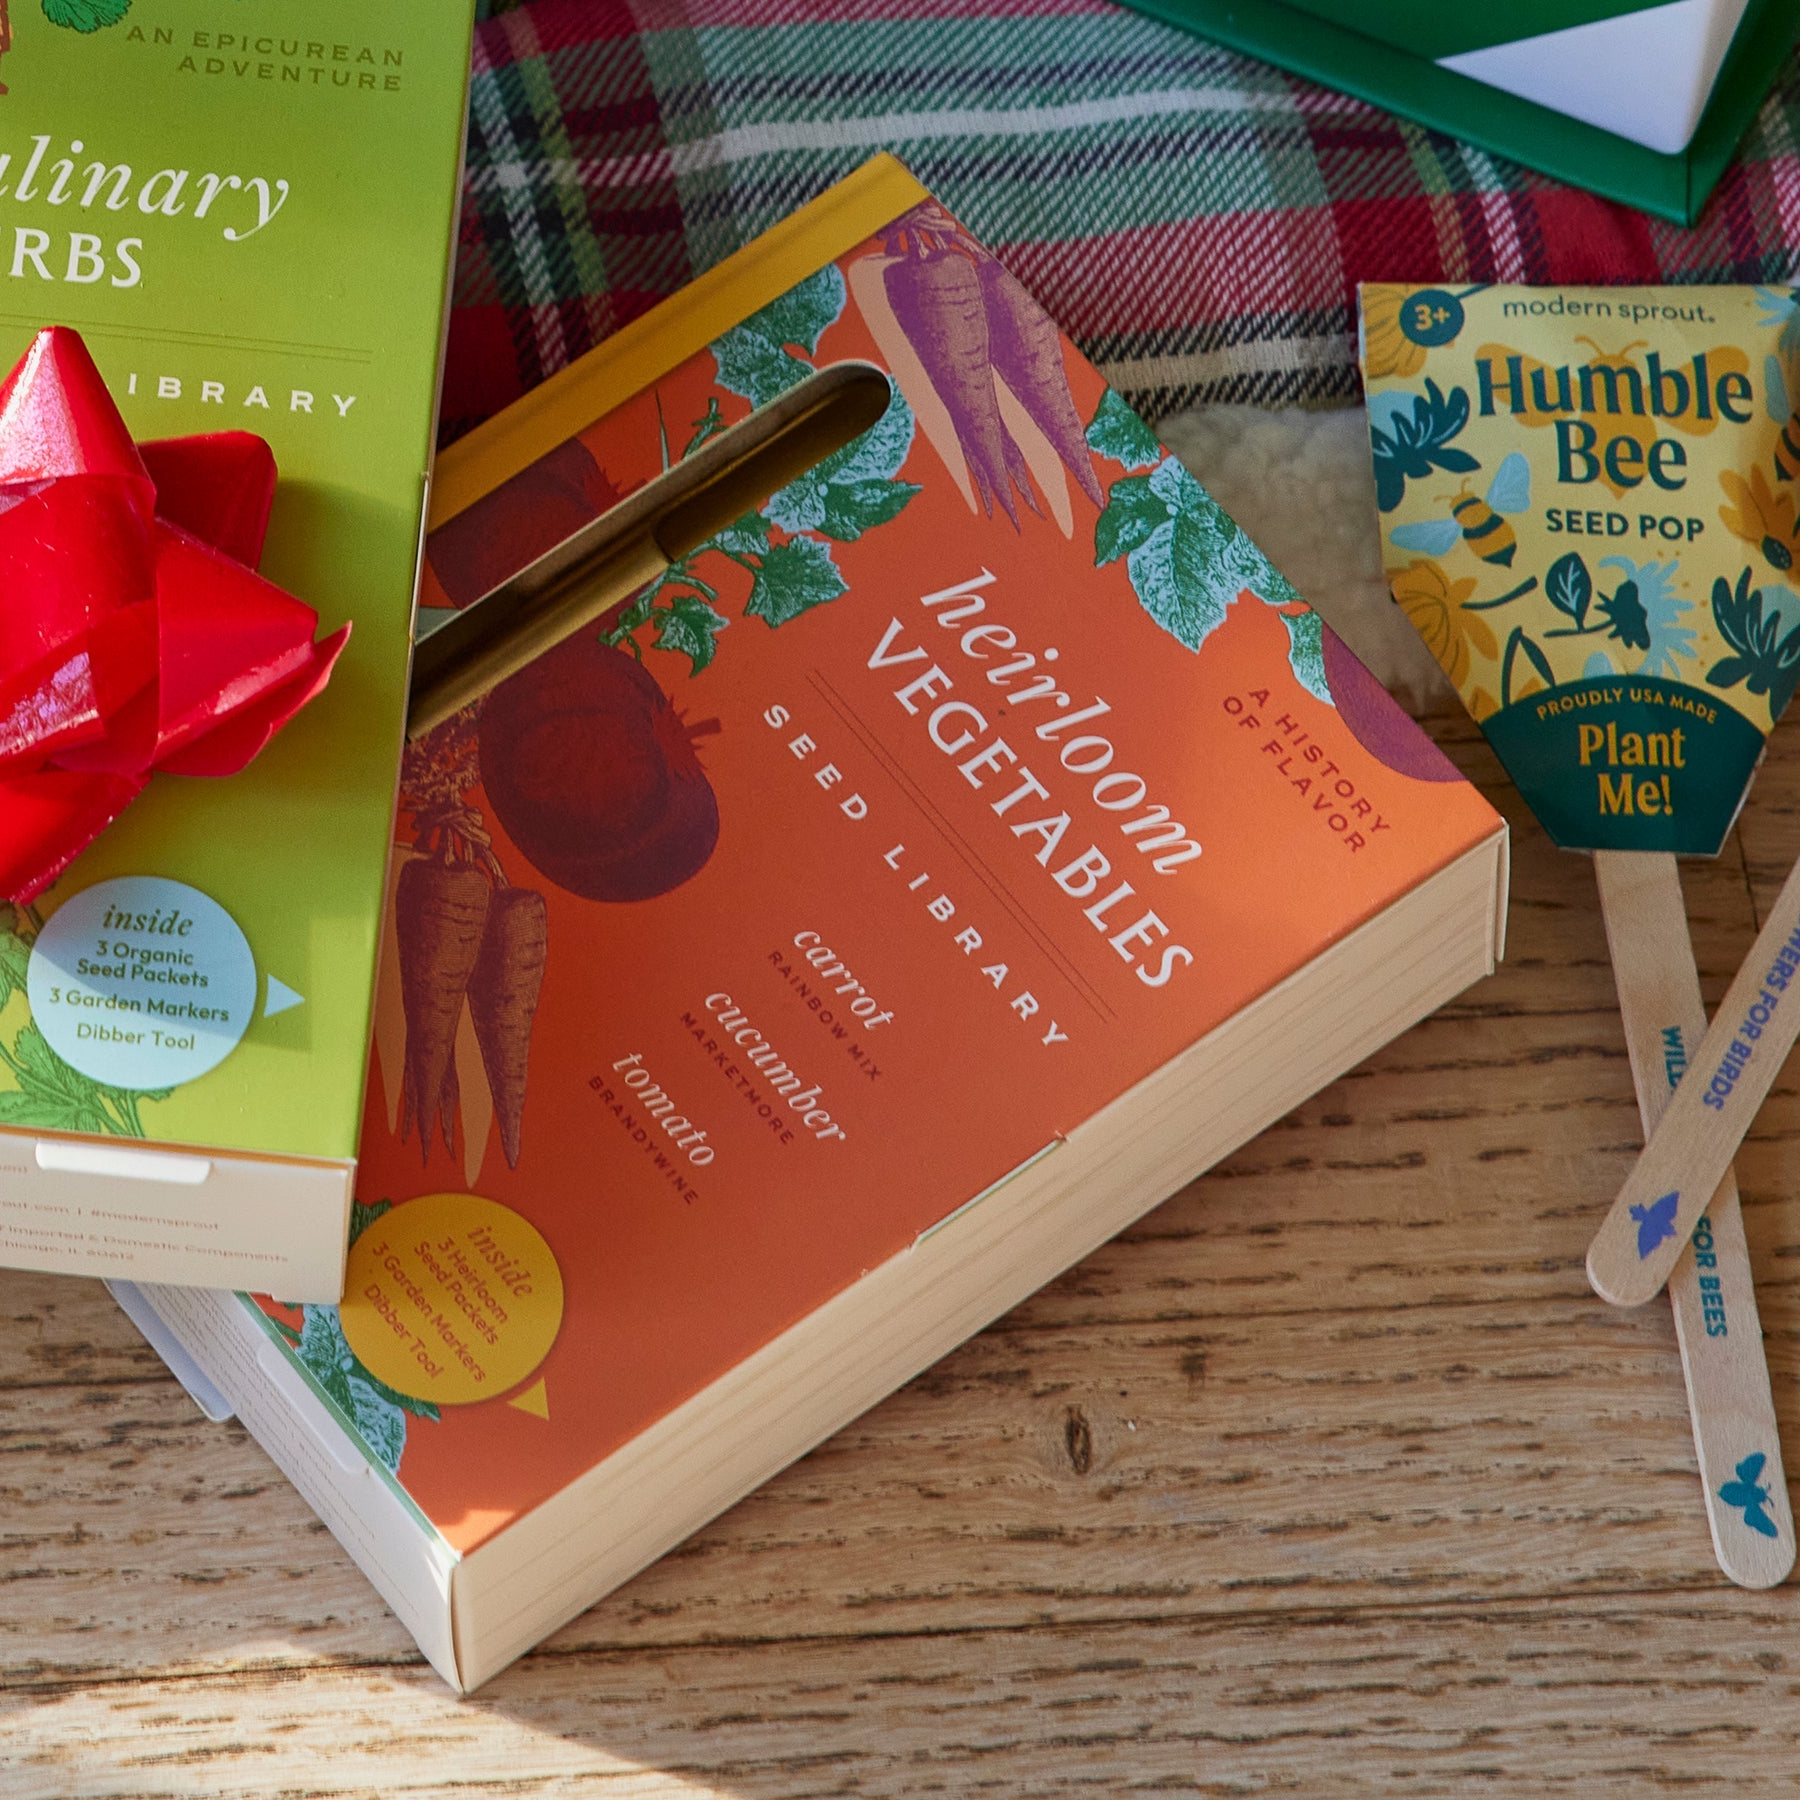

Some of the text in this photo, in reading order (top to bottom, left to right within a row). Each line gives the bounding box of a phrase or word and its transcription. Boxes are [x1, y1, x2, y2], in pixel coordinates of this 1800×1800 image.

[125, 25, 404, 67] AN EPICUREAN
[177, 55, 402, 92] ADVENTURE
[1414, 304, 1451, 331] 3+
[1503, 295, 1612, 318] modern
[105, 372, 359, 417] IBRARY
[1475, 351, 1754, 424] Humble
[1554, 418, 1688, 492] Bee
[1545, 508, 1704, 542] SEED POP
[920, 566, 1203, 876] heirloom
[1537, 687, 1717, 724] PROUDLY USA MADE
[1223, 695, 1366, 853] OF FLAVOR
[1249, 688, 1391, 833] A HISTORY
[1578, 723, 1686, 768] Plant
[867, 617, 1194, 988] VEGETABLES
[1599, 772, 1674, 816] Me!
[763, 703, 1070, 1048] SEED LIBRARY
[96, 940, 194, 966] 3 Organic
[103, 904, 193, 938] inside
[48, 987, 229, 1022] 3 Garden Markers
[76, 958, 209, 987] Seed Packets
[793, 930, 895, 1030] carrot
[76, 1022, 196, 1050] Dibber Tool
[767, 950, 882, 1081] RAINBOW MIX
[1703, 990, 1778, 1111] FOR BIRDS
[680, 1011, 794, 1145] MARKETMORE
[704, 992, 846, 1141] cucumber
[588, 1075, 698, 1205] BRANDYWINE
[612, 1052, 714, 1166] tomato
[414, 1240, 499, 1346] Seed Packets
[437, 1237, 508, 1324] 3 Heirloom
[467, 1225, 532, 1298] inside
[363, 1282, 445, 1380] Dibber Tool
[372, 1241, 486, 1383] 3 Garden Markers
[1698, 1276, 1728, 1337] BEES
